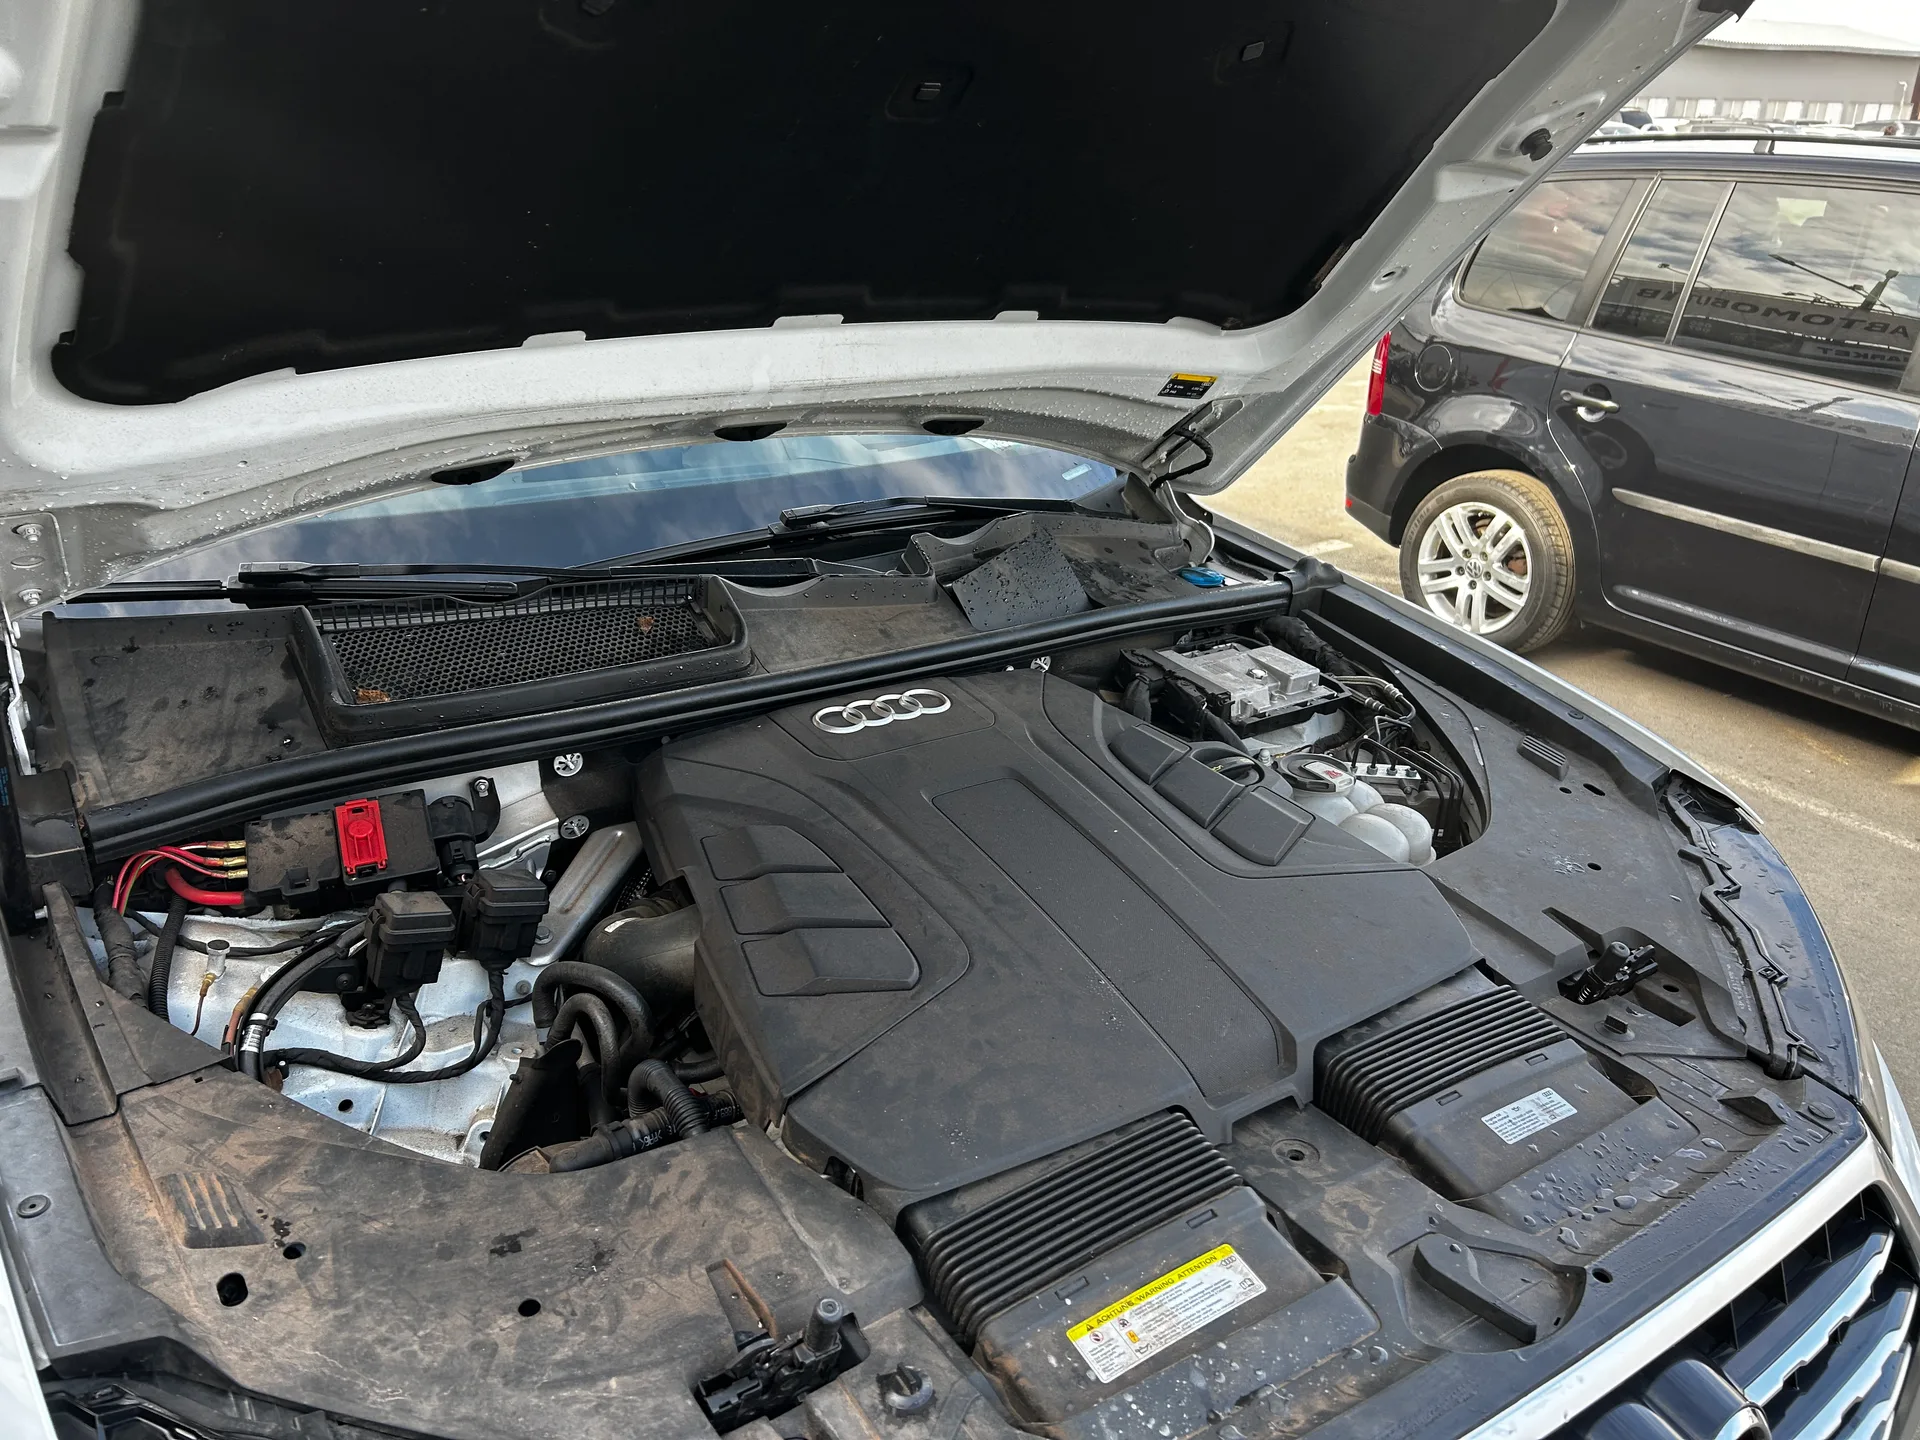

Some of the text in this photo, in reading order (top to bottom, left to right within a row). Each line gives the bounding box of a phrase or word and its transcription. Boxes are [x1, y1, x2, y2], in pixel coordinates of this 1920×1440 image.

[1095, 1301, 1135, 1325] ACHTUNG
[1136, 1278, 1175, 1302] WARNING
[1177, 1255, 1218, 1281] ATTENTION
